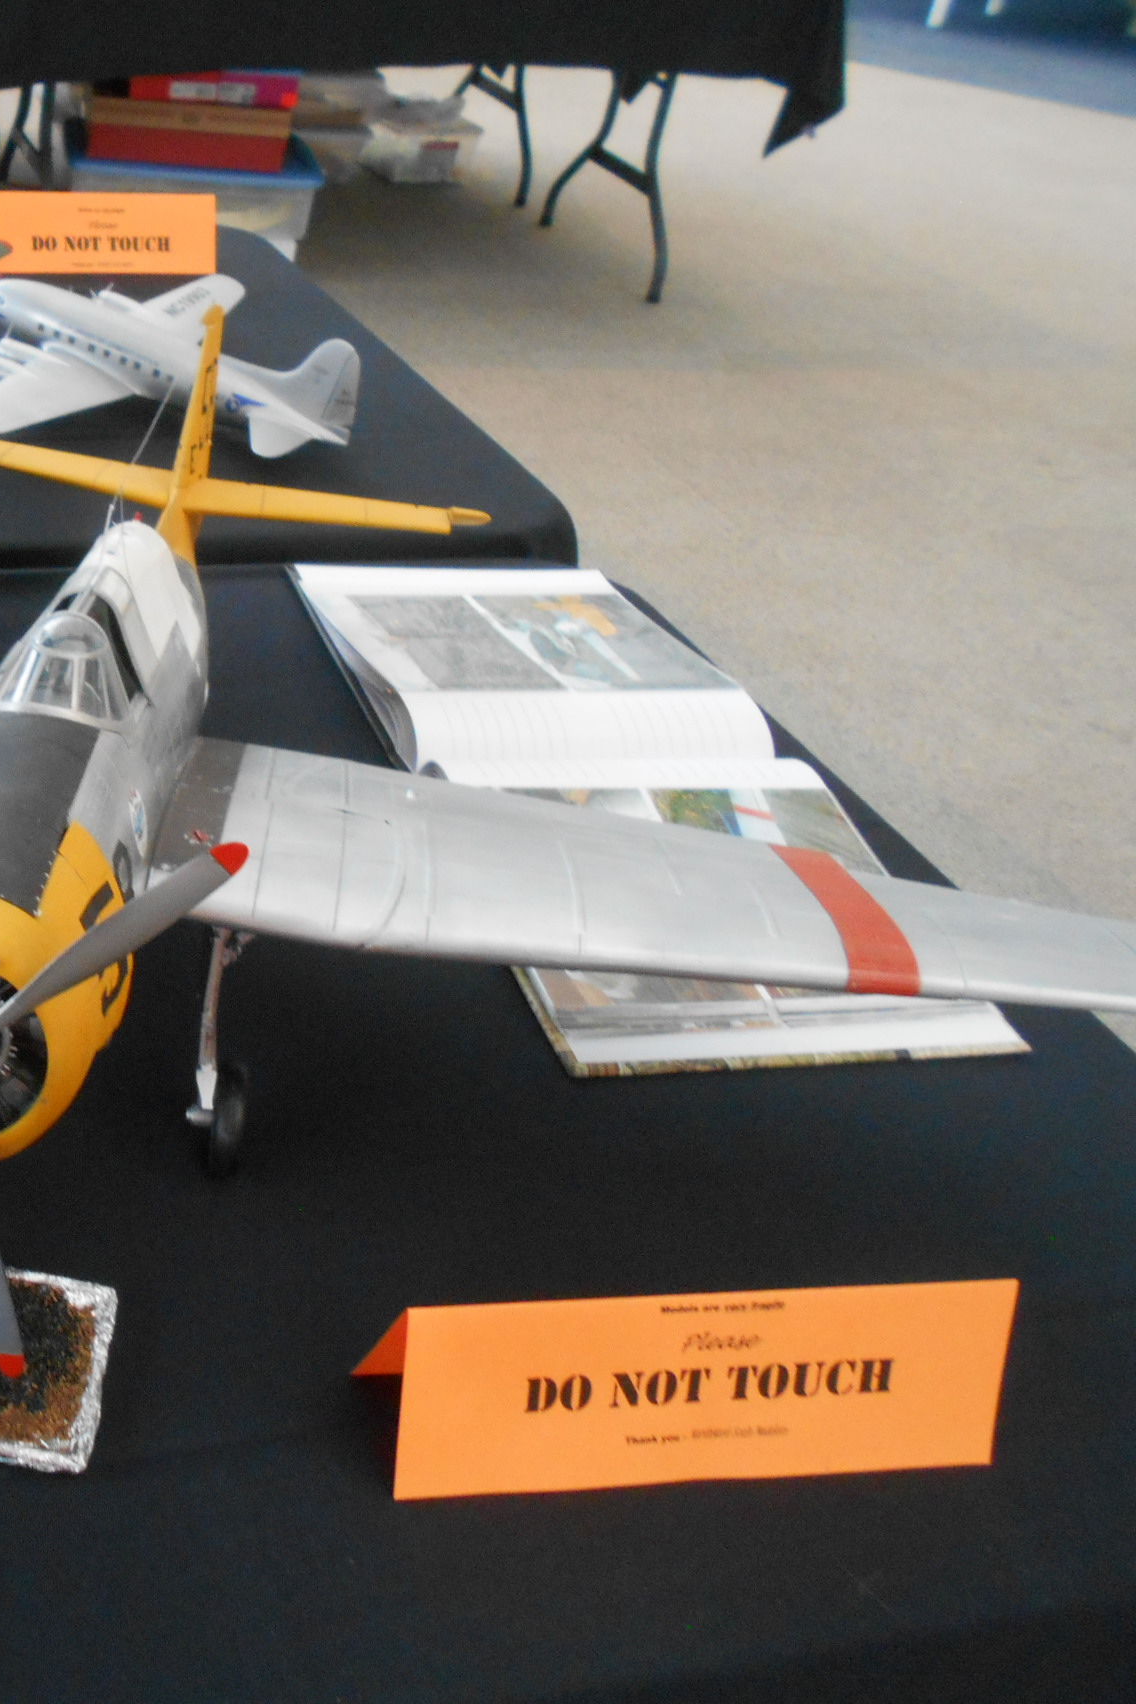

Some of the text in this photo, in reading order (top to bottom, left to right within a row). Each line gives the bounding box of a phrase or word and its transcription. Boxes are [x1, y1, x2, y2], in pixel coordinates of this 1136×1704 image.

[32, 235, 170, 251] DO NOT TOUCH
[681, 1330, 762, 1353] Please
[524, 1357, 895, 1413] DO NOT TOUCH
